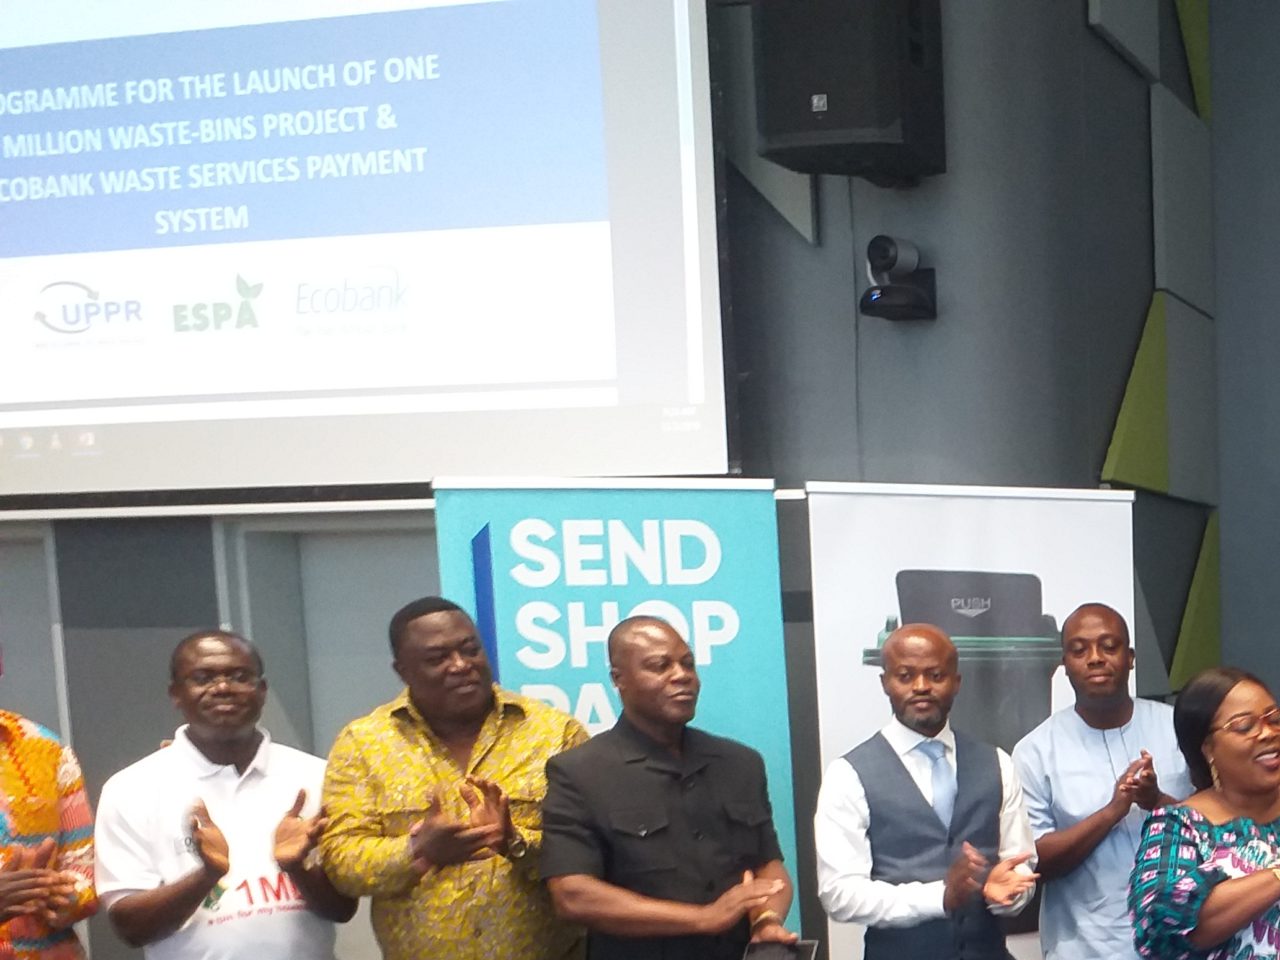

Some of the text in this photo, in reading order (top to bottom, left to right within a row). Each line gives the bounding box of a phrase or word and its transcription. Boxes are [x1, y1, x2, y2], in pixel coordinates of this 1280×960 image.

[0, 54, 441, 116] GRAMME FOR THE LAUNCH OF ONE
[3, 103, 398, 158] MILLION WASTE-BINS PROJECT &
[99, 165, 183, 195] WASTE
[188, 156, 300, 189] SERVICES
[307, 146, 428, 179] PAYMENT
[155, 205, 249, 235] SYSTEM
[62, 299, 143, 326] UPPR
[173, 298, 260, 332] ESPA
[295, 271, 410, 315] Ecobank
[508, 517, 722, 588] SEND
